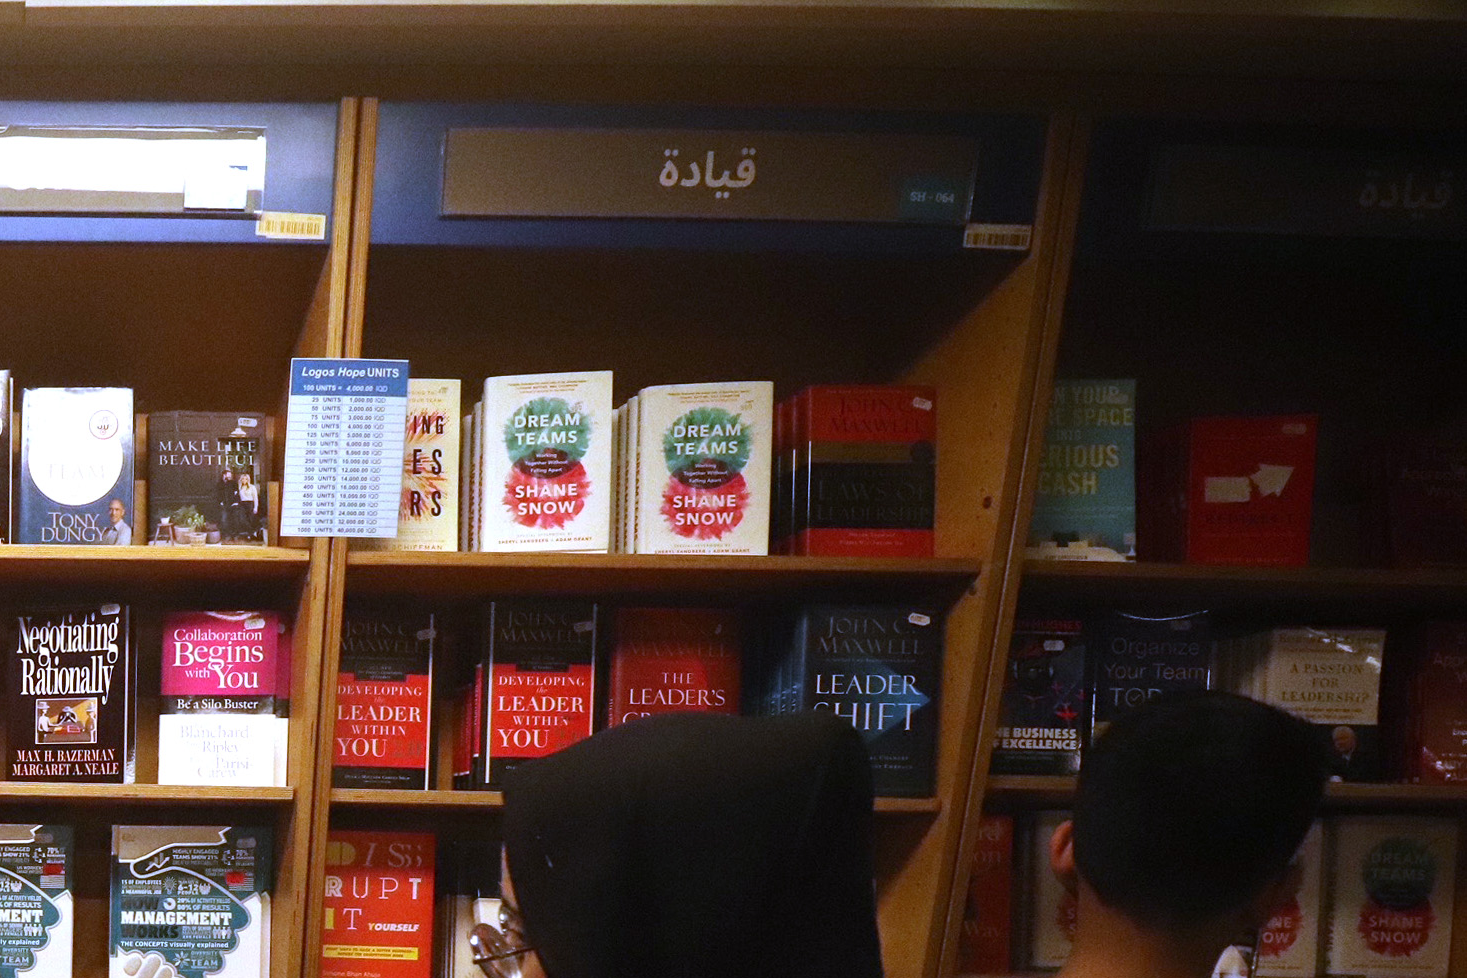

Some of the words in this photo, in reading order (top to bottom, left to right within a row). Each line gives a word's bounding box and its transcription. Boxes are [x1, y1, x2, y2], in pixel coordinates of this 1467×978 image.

[658, 147, 757, 199] قيادة
[302, 367, 334, 378] Logos
[338, 367, 365, 378] Hope
[367, 368, 399, 377] UNITS
[514, 413, 580, 428] DREAM
[674, 423, 741, 438] DREAM
[515, 431, 577, 445] TEAMS
[159, 440, 208, 452] MAKE
[217, 440, 256, 451] LIFE
[674, 442, 738, 455] TEAMS
[159, 454, 257, 466] BEAUTIFUL
[515, 484, 577, 498] SHANE
[518, 501, 575, 515] SNOW
[673, 495, 736, 508] SHANE
[48, 512, 100, 528] TONY
[675, 513, 734, 525] SNOW
[42, 528, 106, 542] DUNGY
[17, 613, 120, 666] Negotiating
[174, 629, 262, 641] Collaboration
[1111, 638, 1199, 659] Organize
[172, 642, 264, 670] Begins
[185, 668, 210, 678] with
[212, 665, 258, 688] You
[663, 672, 694, 684] THE
[1103, 663, 1146, 680] Your
[1154, 665, 1204, 680] Team
[20, 656, 114, 704] Rationally
[498, 676, 584, 686] DEVELOPING
[815, 674, 920, 696] LEADER
[338, 686, 422, 696] DEVELOPING
[629, 689, 726, 706] LEADER'S
[177, 699, 190, 709] Be
[202, 699, 222, 709] Silo
[224, 699, 258, 709] Buster
[497, 696, 584, 713] LEADER
[338, 705, 422, 723] LEADER
[512, 715, 568, 726] WITHIN
[352, 725, 406, 736] WITHIN
[1013, 728, 1077, 740] BUSINESS
[498, 729, 550, 748] YOU
[1003, 738, 1078, 750] EXCELLENCE
[337, 738, 386, 758] YOU
[17, 750, 40, 762] MAX
[44, 750, 55, 762] H.
[58, 749, 114, 762] BAZERMAN
[12, 764, 70, 776] MARGARET
[84, 762, 118, 775] NEALE
[121, 911, 231, 926] MANAGEMENT
[368, 923, 420, 932] YOURSELF
